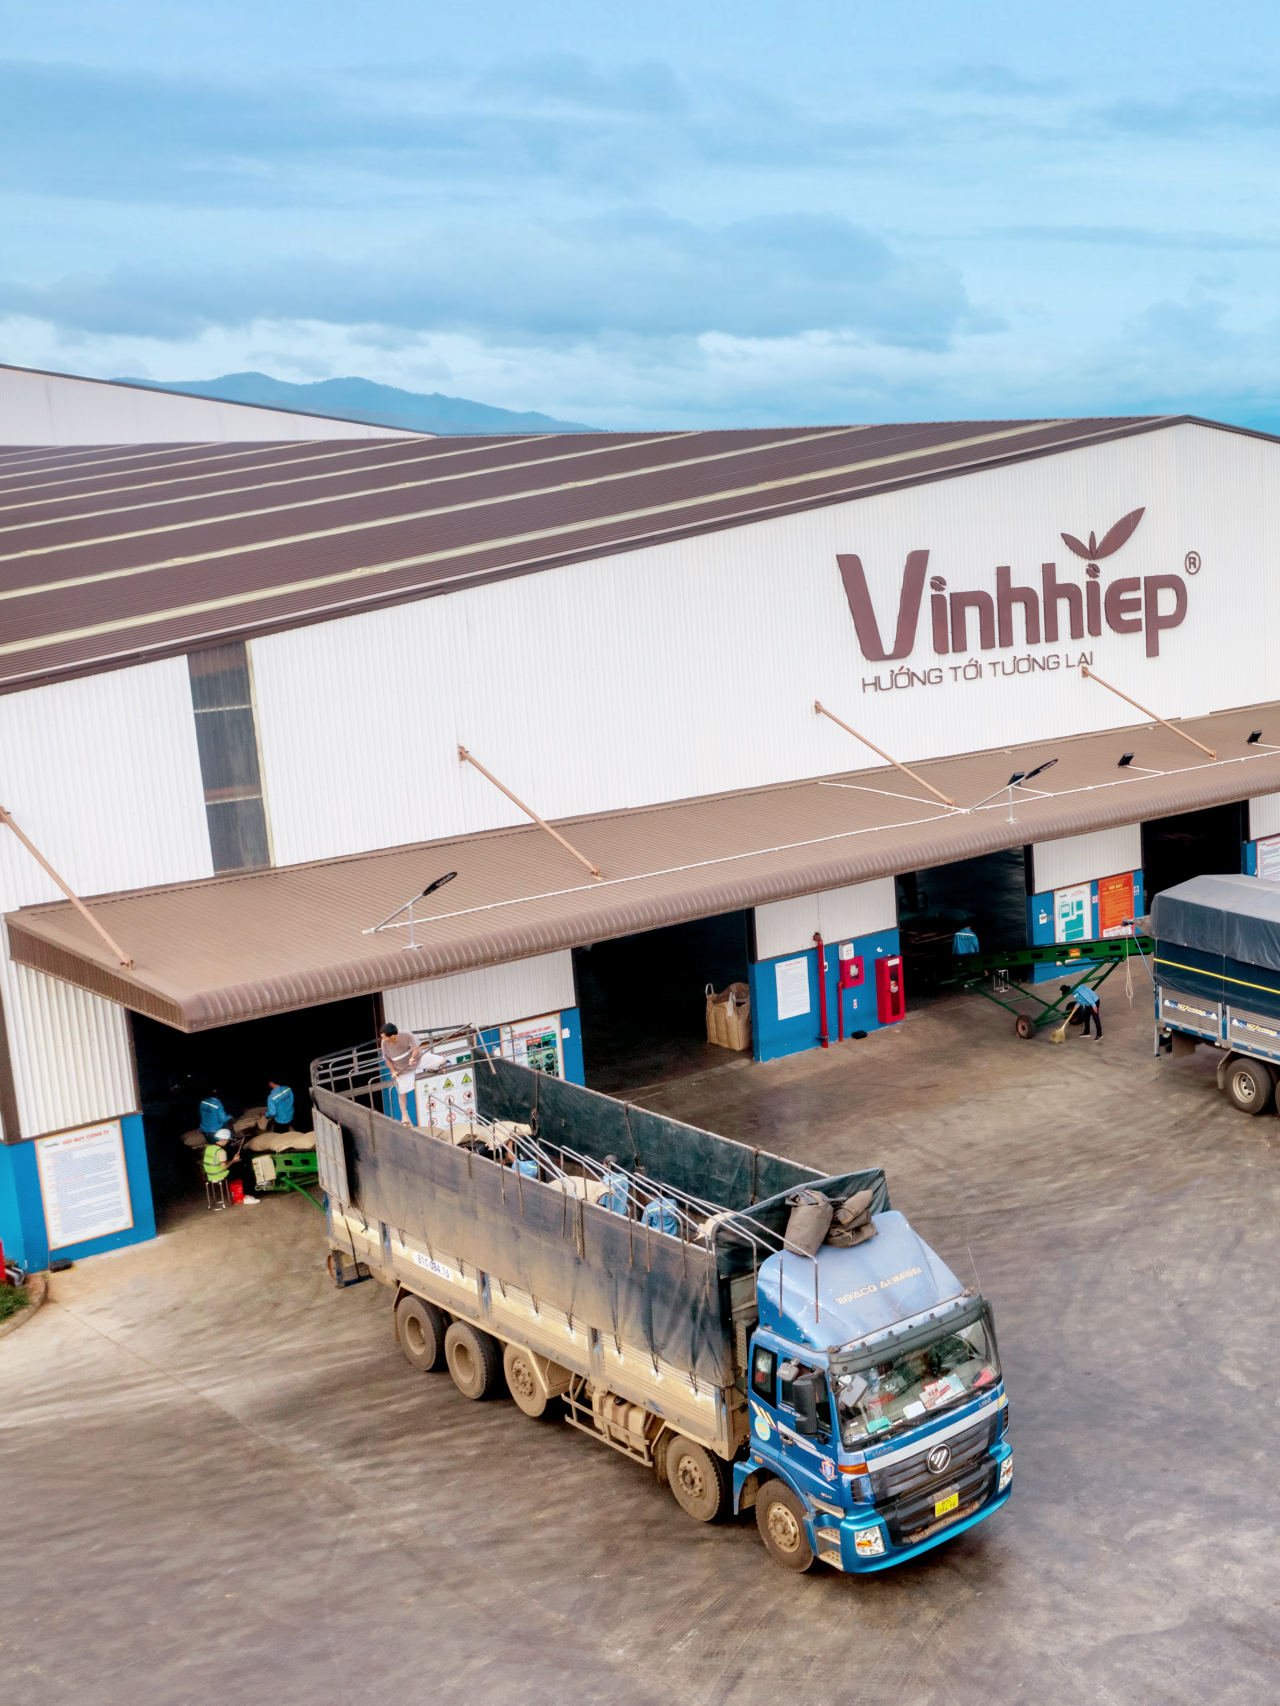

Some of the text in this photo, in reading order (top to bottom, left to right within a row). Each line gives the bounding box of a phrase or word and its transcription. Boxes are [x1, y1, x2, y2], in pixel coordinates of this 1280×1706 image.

[862, 651, 1094, 693] HƯỚNG TỚI TƯƠNG LAI
[834, 1266, 922, 1305] THACO AUMAN
